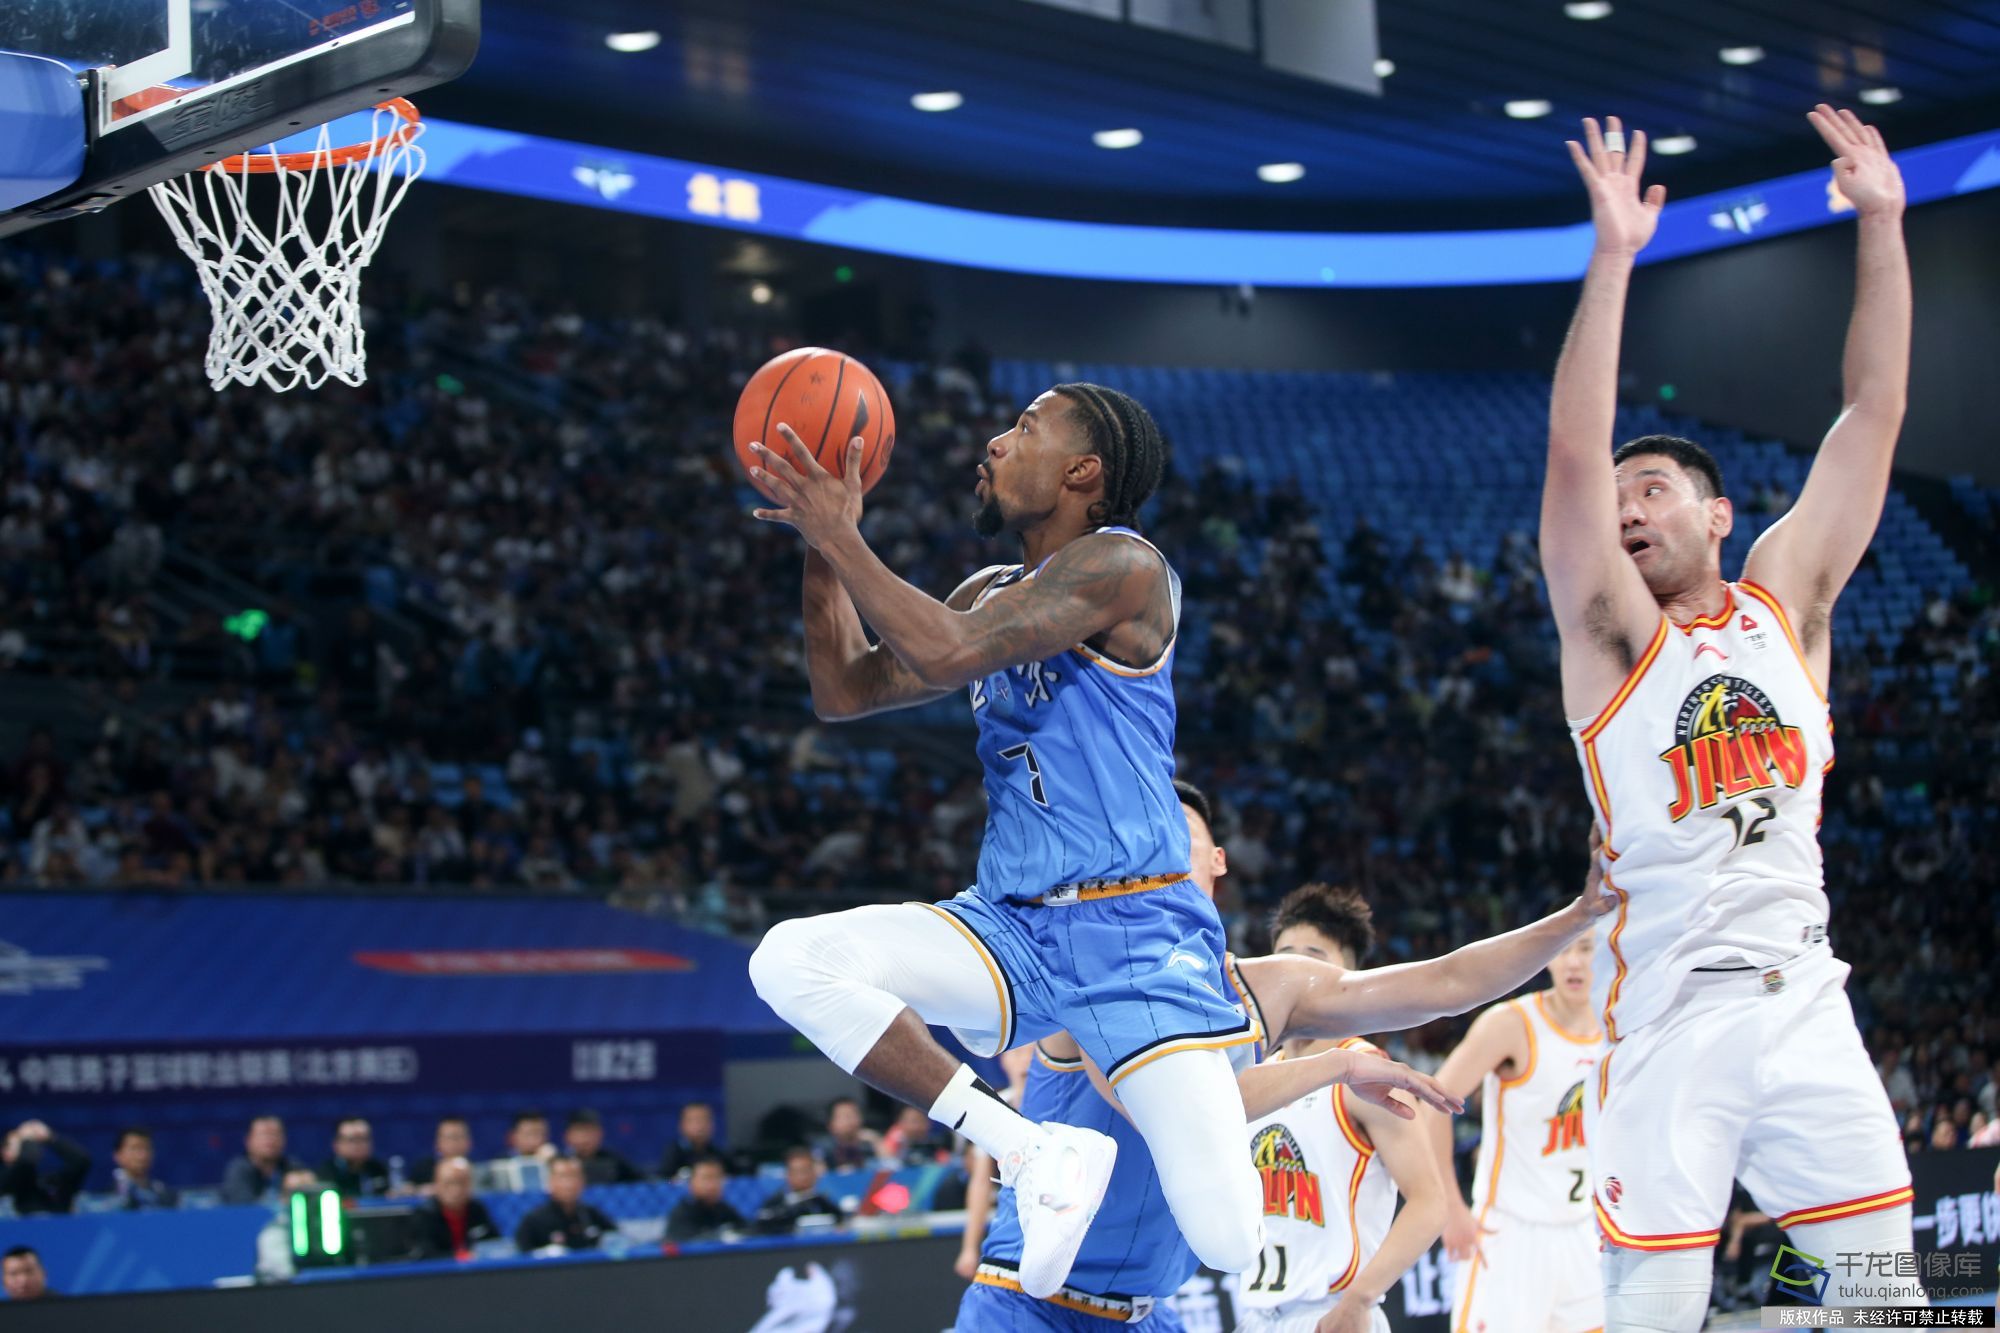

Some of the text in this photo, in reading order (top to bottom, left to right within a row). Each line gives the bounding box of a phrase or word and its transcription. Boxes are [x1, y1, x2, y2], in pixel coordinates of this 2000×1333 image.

[997, 741, 1048, 807] 7
[1660, 725, 1807, 823] JILIN
[1721, 797, 1777, 853] 12
[1262, 1165, 1326, 1228] LIN
[1248, 1244, 1287, 1292] 11
